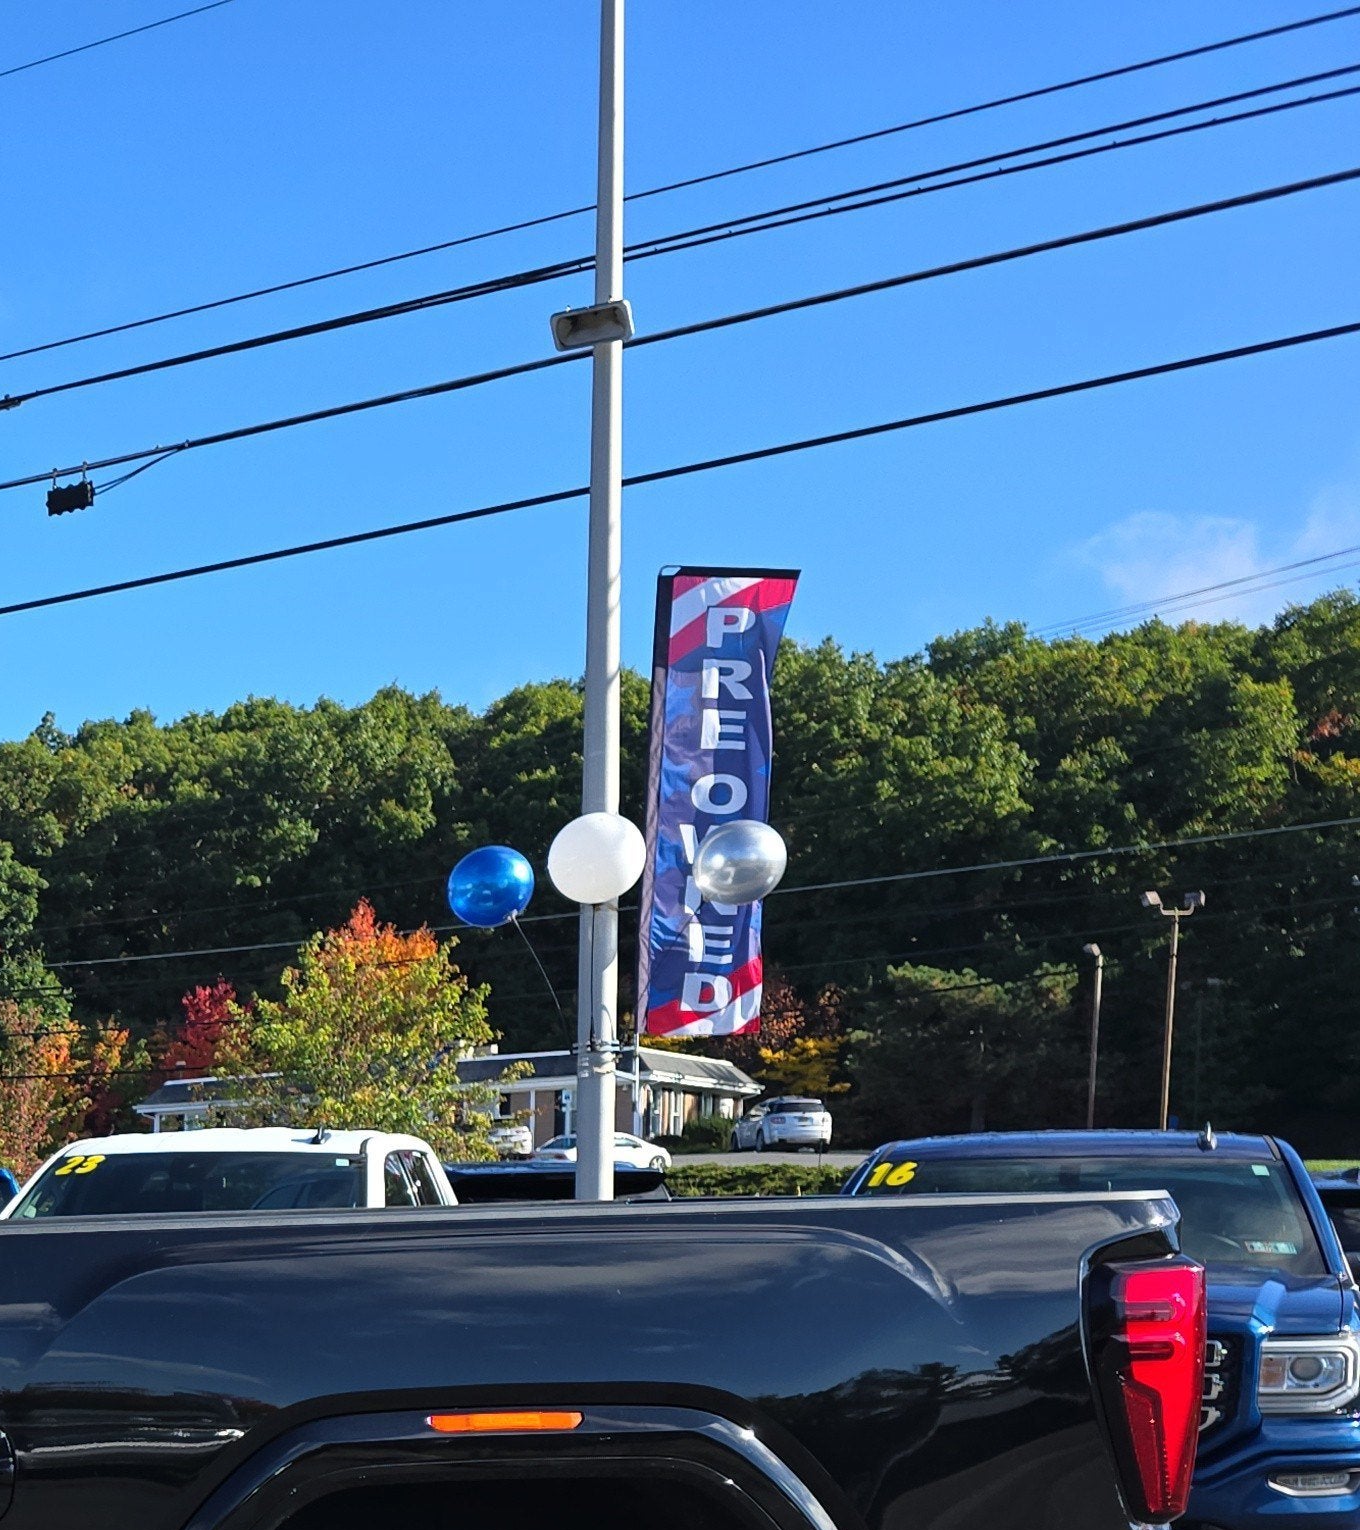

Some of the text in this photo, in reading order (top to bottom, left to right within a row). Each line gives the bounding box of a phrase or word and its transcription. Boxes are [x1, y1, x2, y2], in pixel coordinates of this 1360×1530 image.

[699, 606, 756, 751] PRE
[54, 1154, 106, 1176] 23
[867, 1162, 918, 1187] 16
